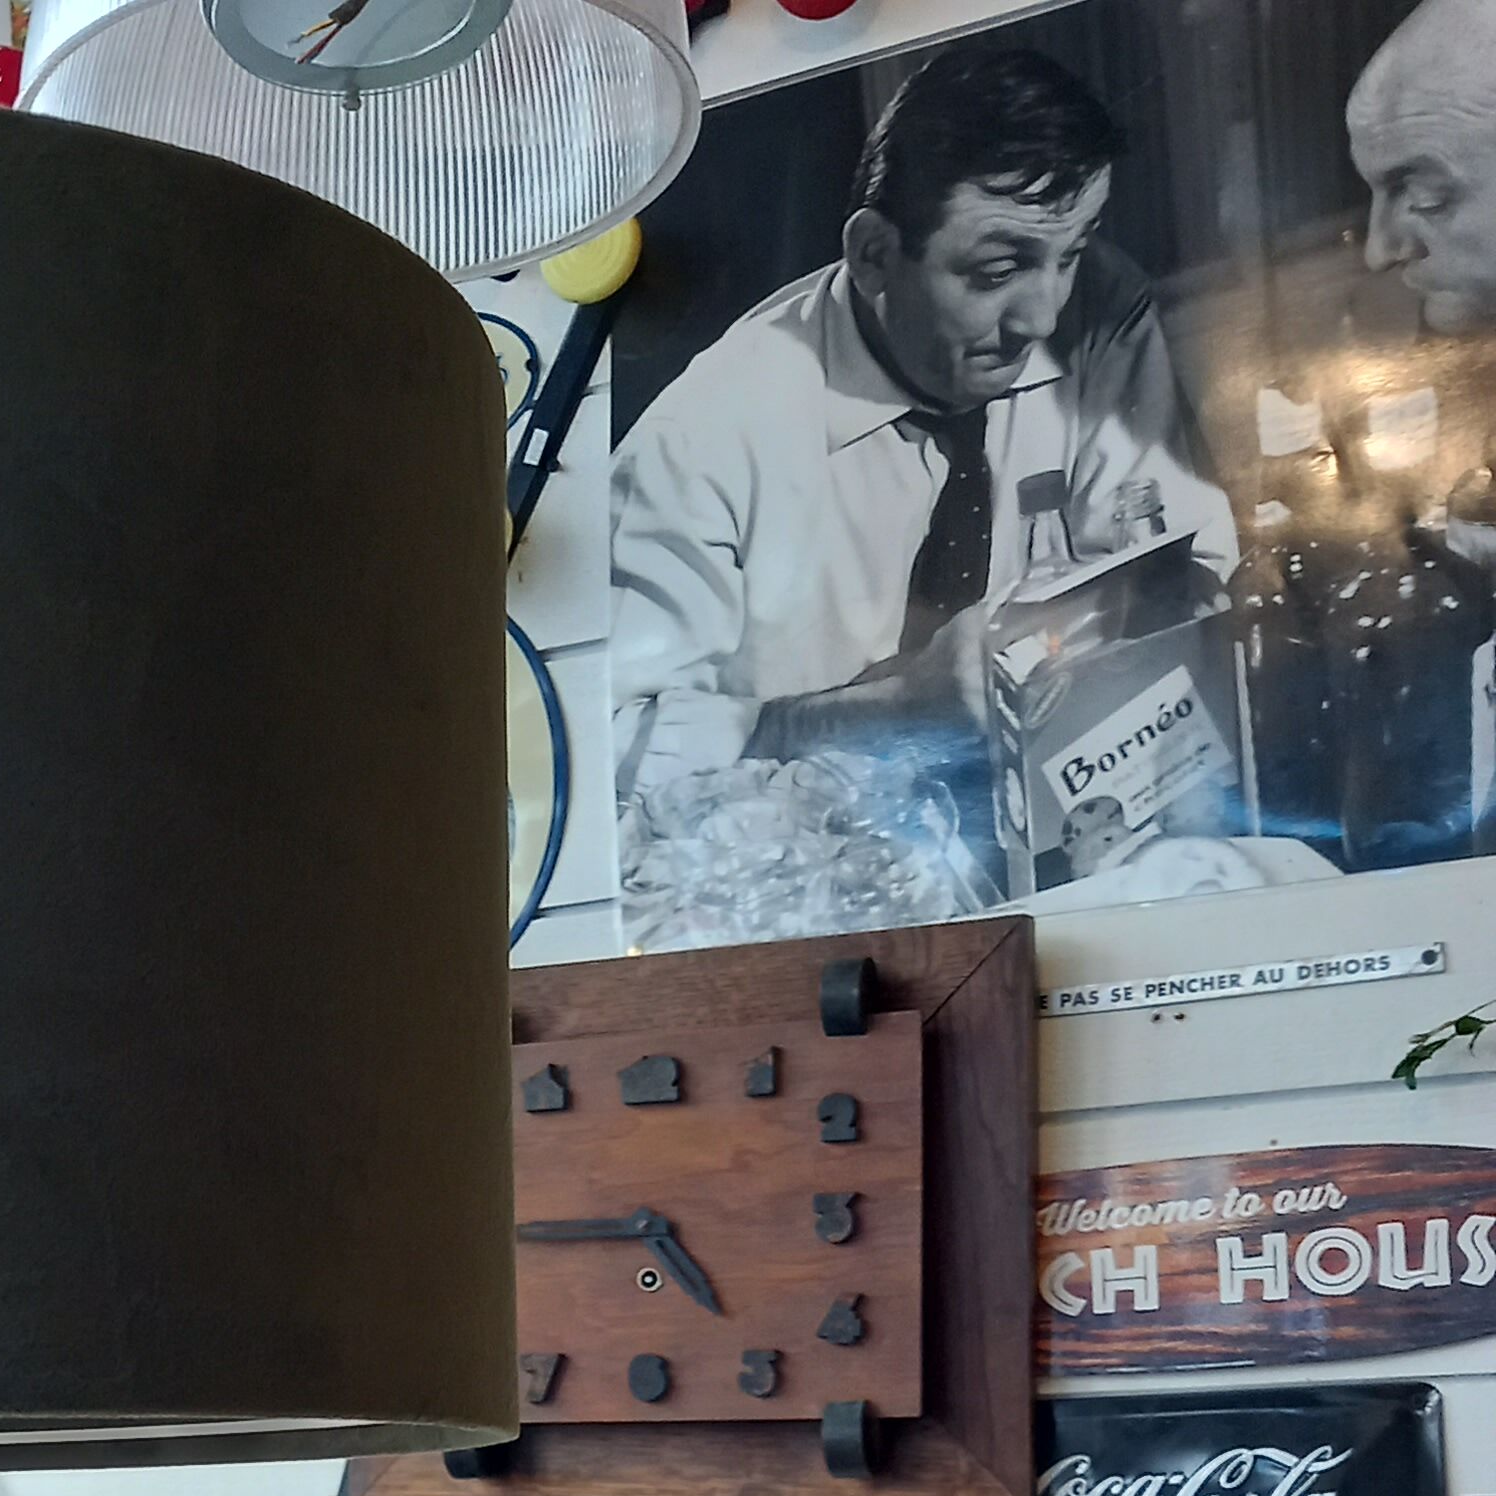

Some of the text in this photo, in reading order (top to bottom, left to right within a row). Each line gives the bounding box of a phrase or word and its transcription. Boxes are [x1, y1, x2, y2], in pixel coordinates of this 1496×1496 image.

[1060, 697, 1194, 797] Bornéo
[1059, 992, 1099, 1009] PAS
[1110, 985, 1134, 1004] SE
[1144, 972, 1242, 999] PENCHER
[1252, 967, 1285, 984] AU
[1296, 955, 1391, 981] DEHORS
[817, 1092, 860, 1143] 2
[1039, 1180, 1348, 1236] Welcome to our
[1038, 1244, 1160, 1318] CH
[817, 1295, 864, 1346] 4
[521, 1353, 566, 1404] 7
